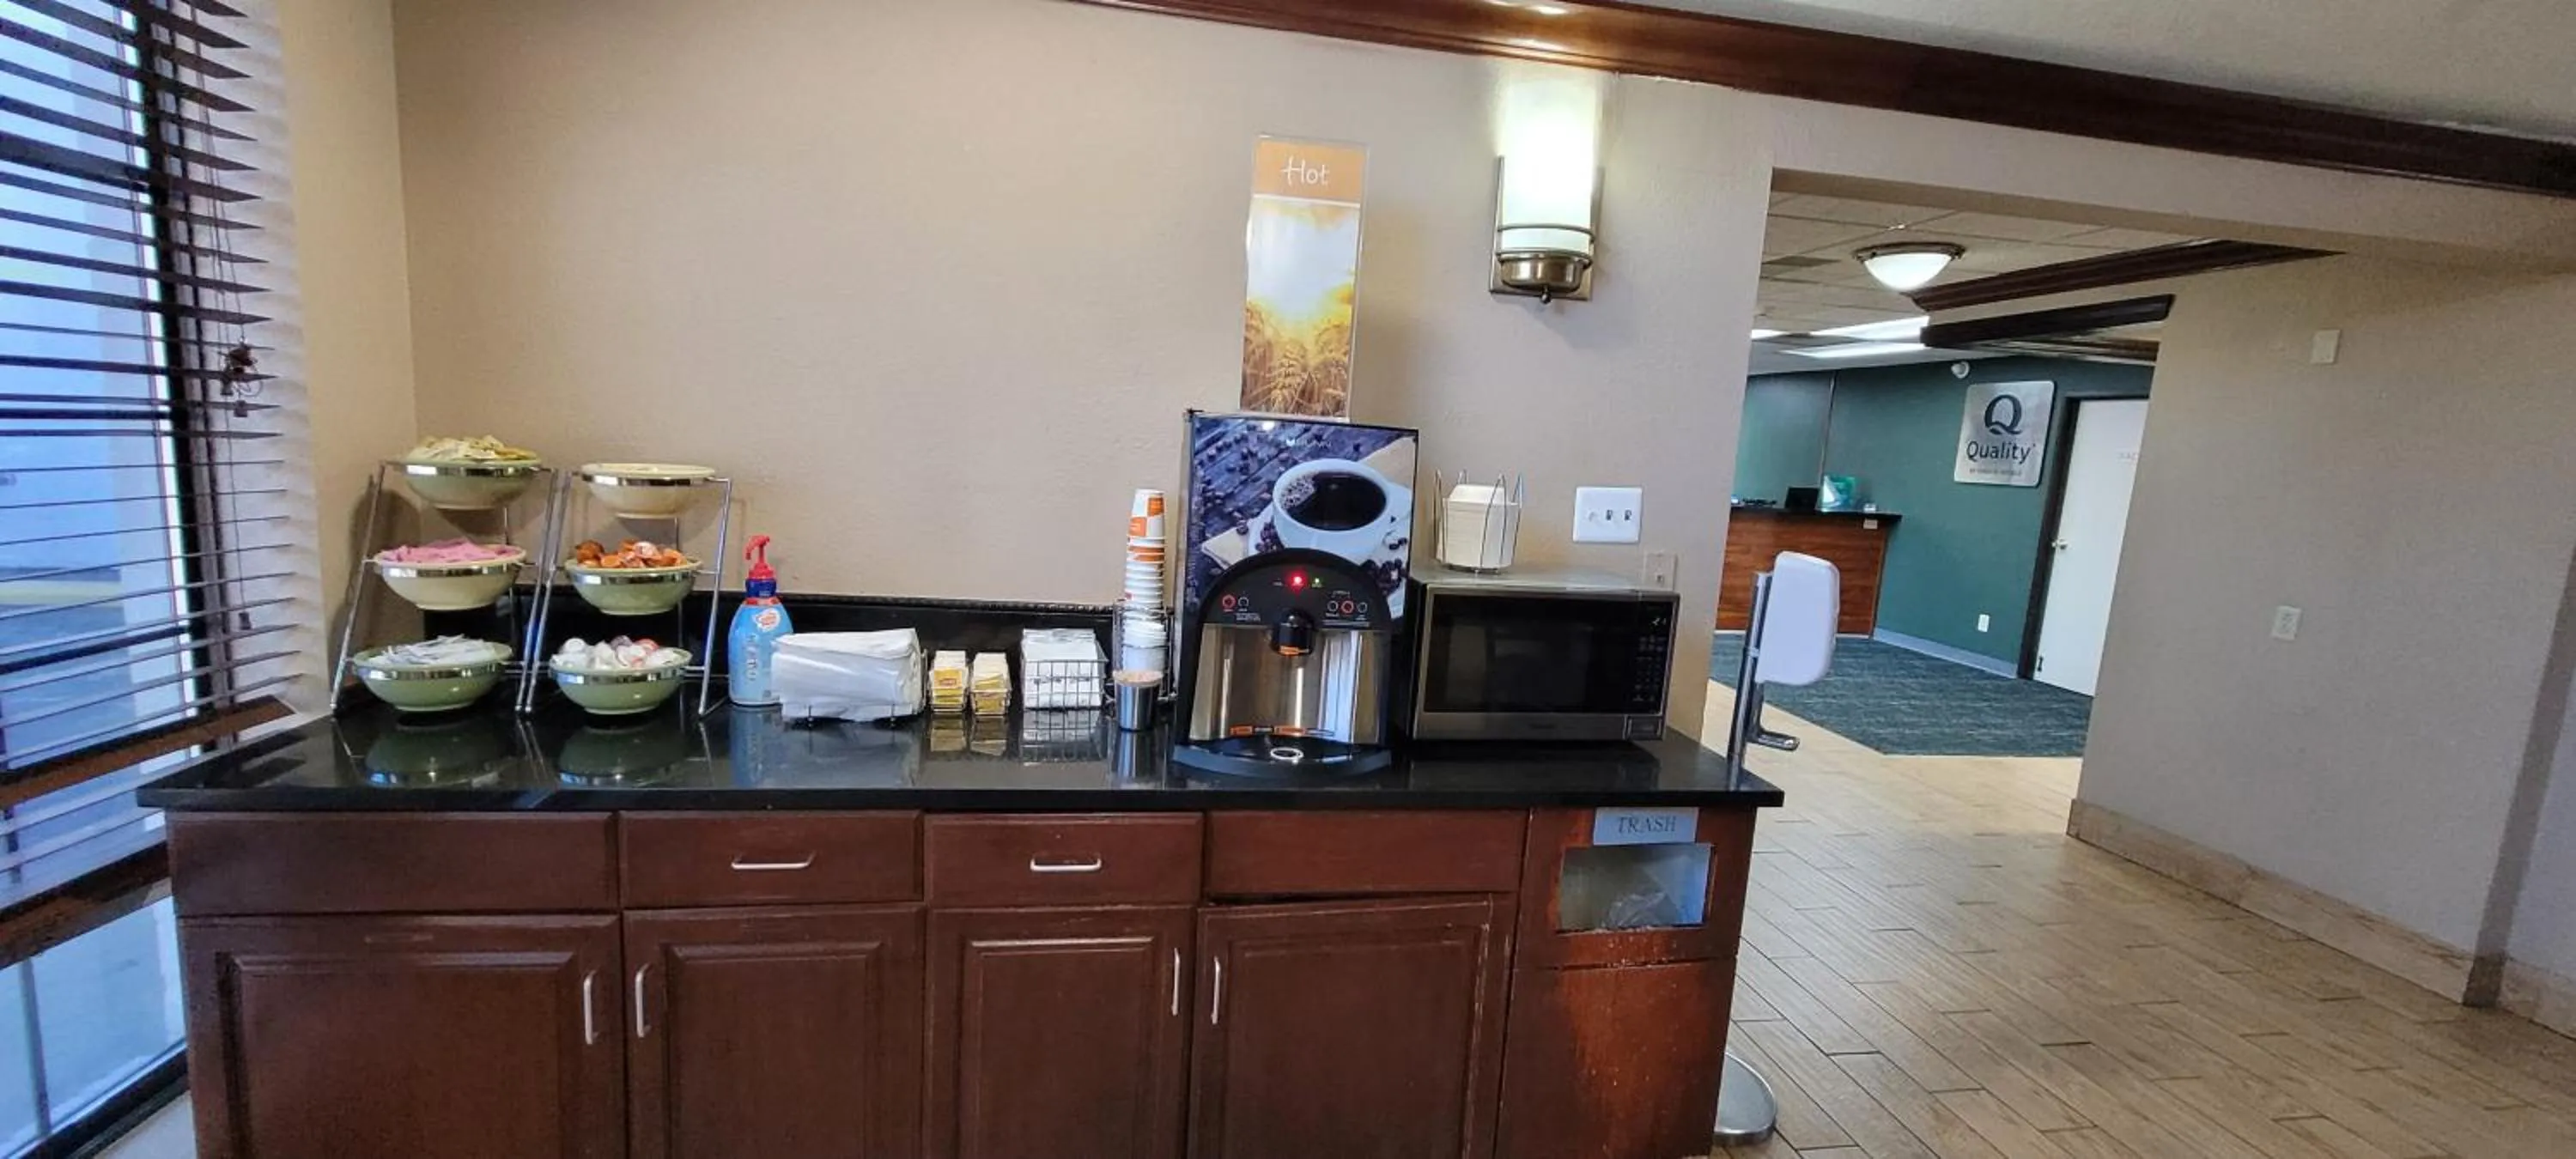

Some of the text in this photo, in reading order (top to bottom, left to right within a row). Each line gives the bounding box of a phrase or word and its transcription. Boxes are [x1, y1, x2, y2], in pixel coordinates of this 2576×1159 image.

[1280, 155, 1330, 186] Hot
[1984, 394, 2023, 435] Q
[1966, 440, 2032, 464] Quality
[1618, 816, 1677, 834] TRASH
